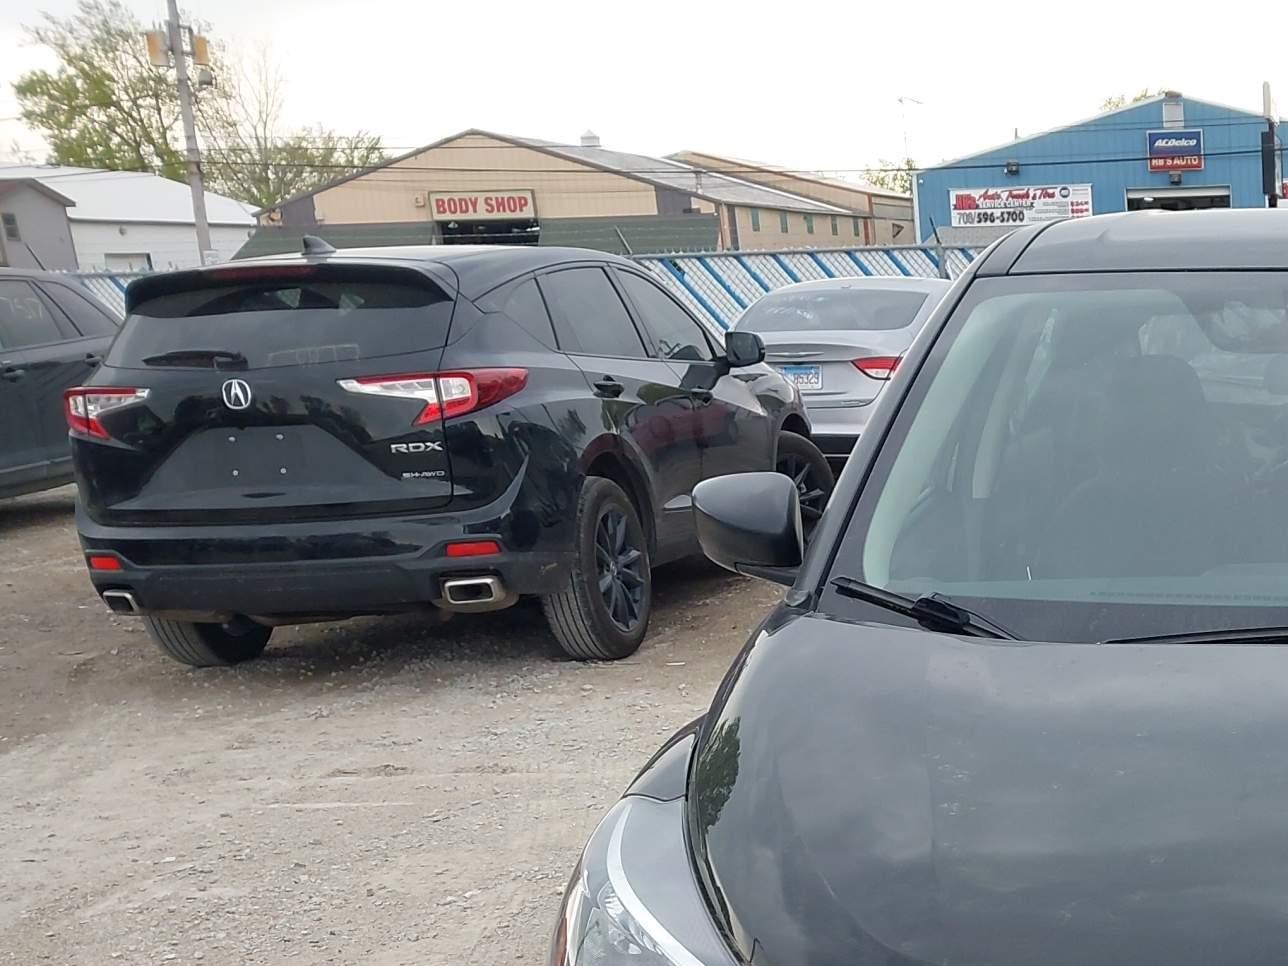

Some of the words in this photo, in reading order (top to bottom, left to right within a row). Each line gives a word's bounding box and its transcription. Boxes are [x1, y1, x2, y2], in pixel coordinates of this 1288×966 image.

[1154, 138, 1197, 147] ACDelco
[1173, 156, 1199, 165] AUTO
[435, 197, 478, 214] BODY
[484, 196, 528, 213] SHOP
[979, 200, 1004, 208] SERVICE
[1006, 199, 1031, 208] CENTER
[390, 441, 443, 453] RDX
[402, 470, 445, 478] SH-AWD
